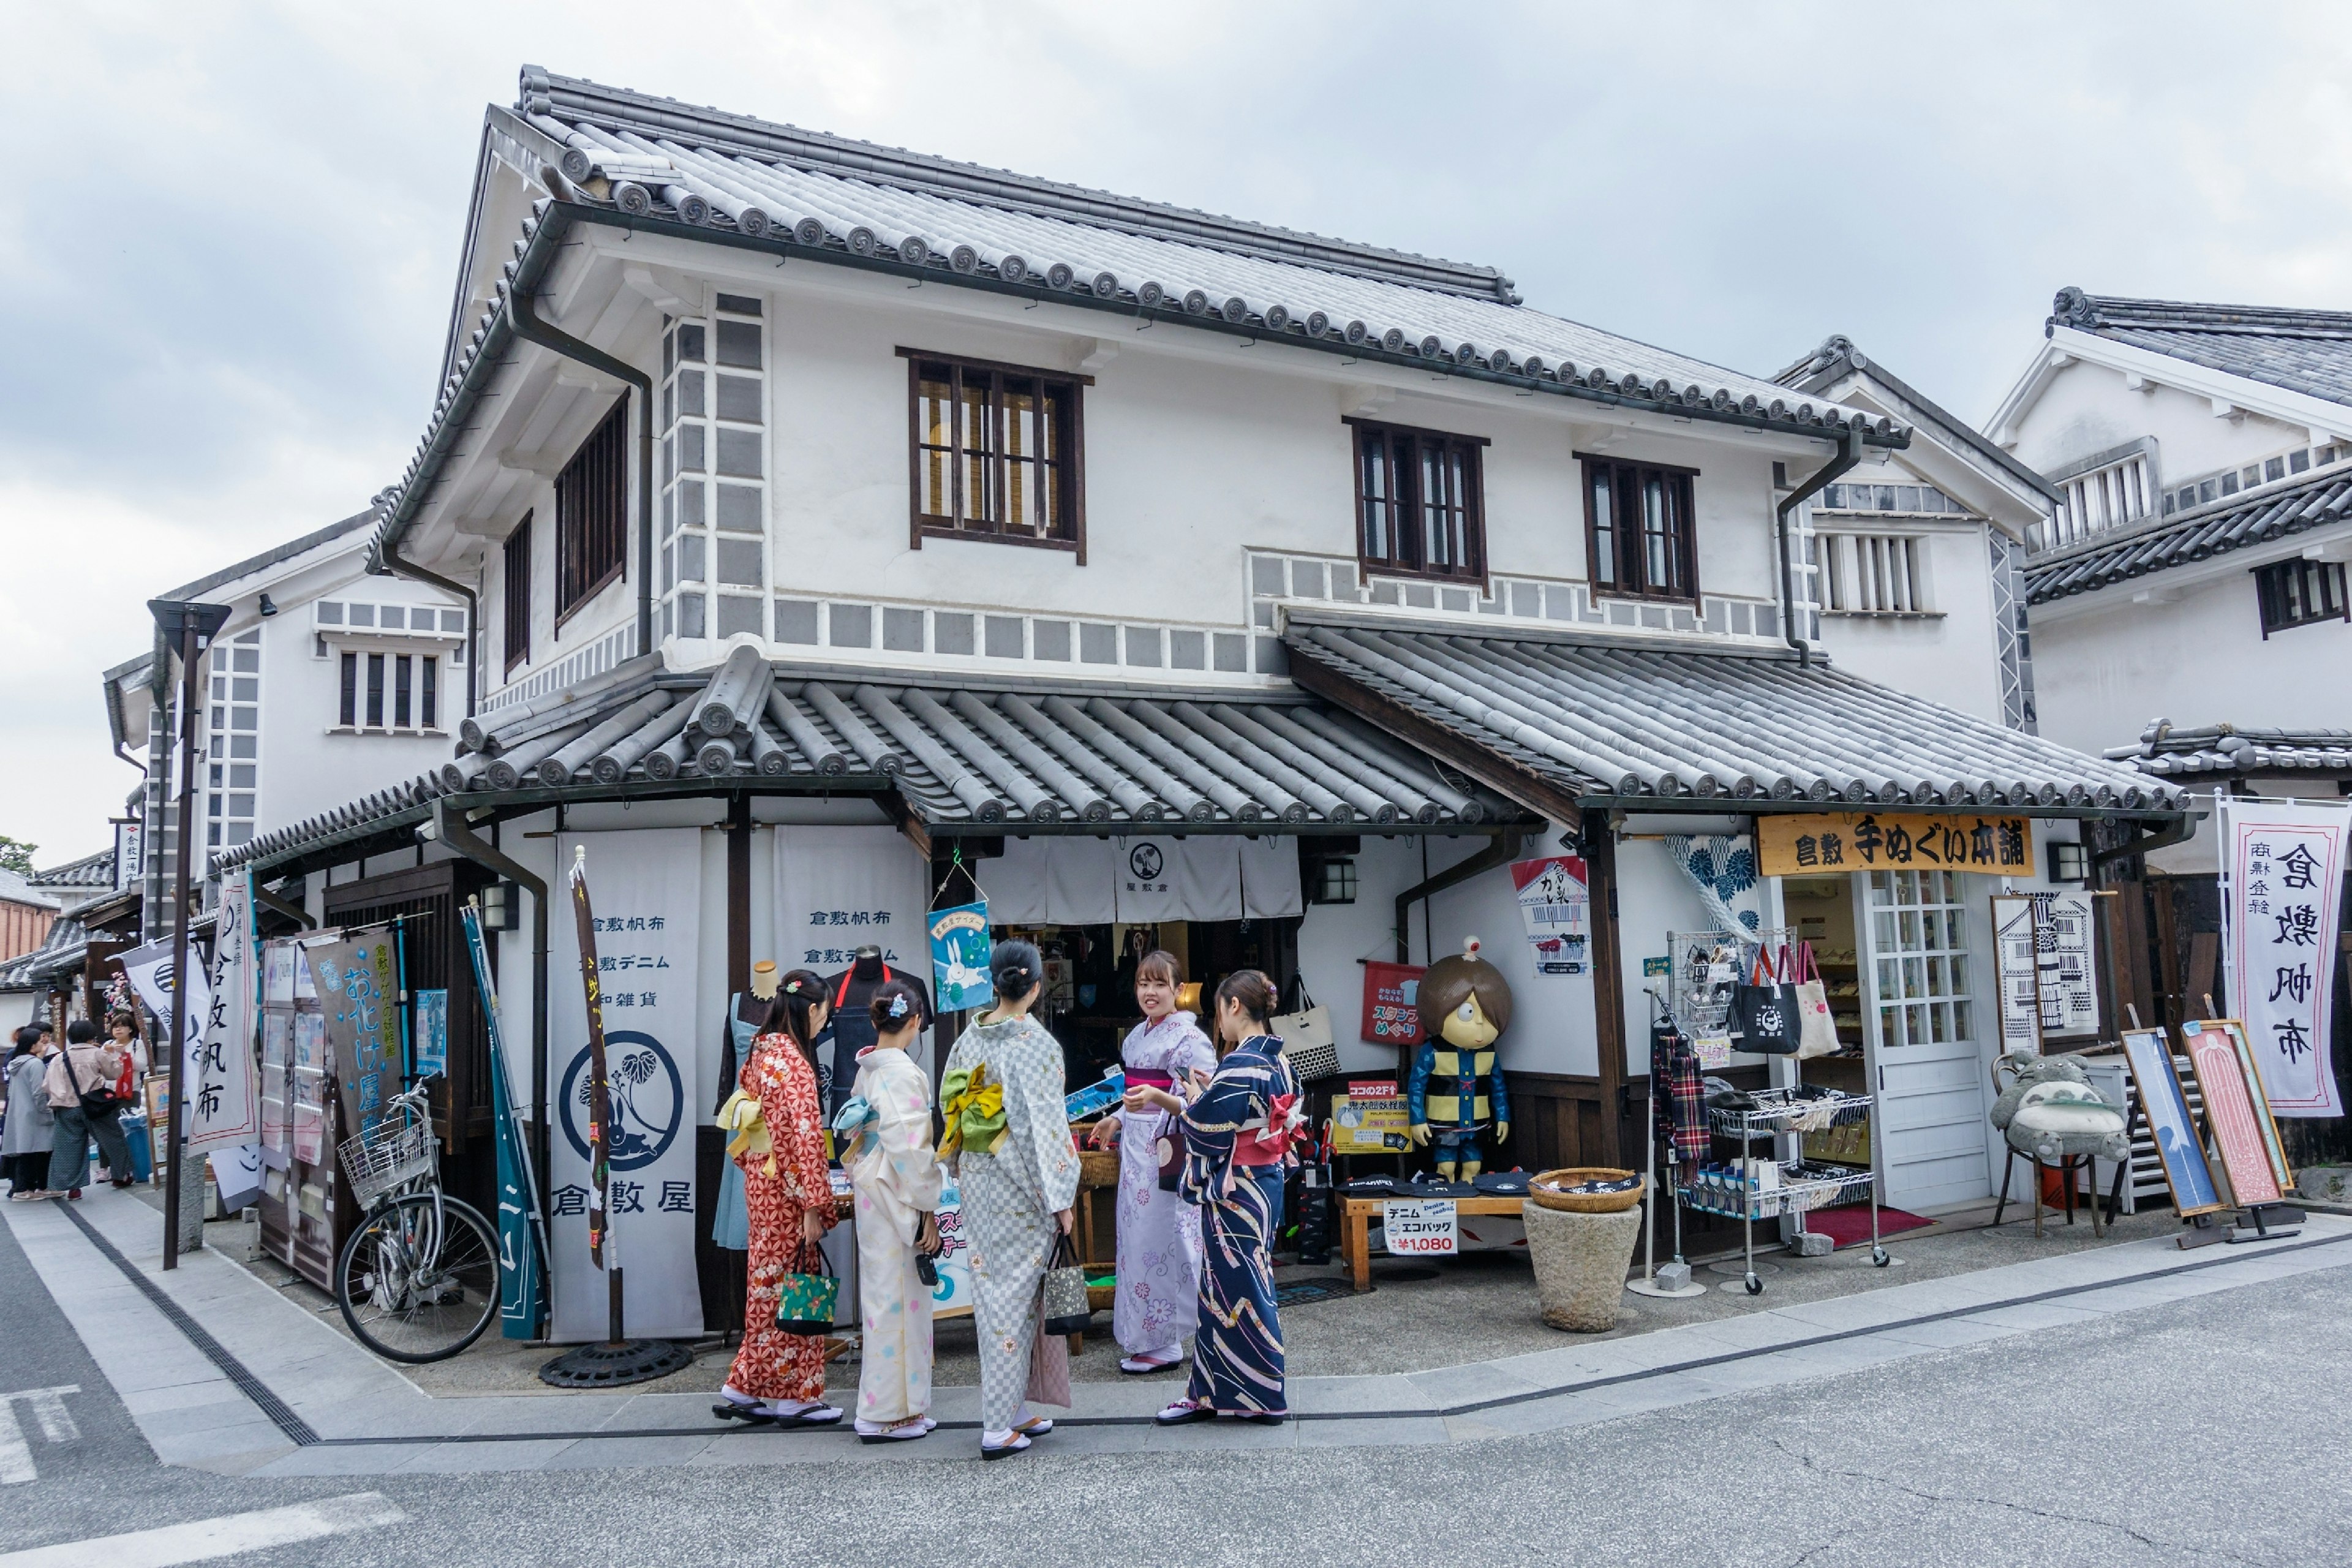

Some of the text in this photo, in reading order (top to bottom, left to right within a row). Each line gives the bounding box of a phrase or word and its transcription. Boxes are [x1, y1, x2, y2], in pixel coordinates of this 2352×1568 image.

[1795, 815, 2025, 866] 倉敷 手ぬぐい本舗
[810, 910, 891, 925] 倉敷帆布
[579, 954, 669, 971] 敷デニム
[319, 959, 343, 993] 妖怪
[1695, 967, 1708, 976] UV
[375, 944, 396, 1059] 倉敷ゲゲゲの妖怪館
[1375, 1020, 1416, 1038] めぐり
[551, 1180, 695, 1216] 倉敷屋
[1389, 1208, 1420, 1219] デニム
[1424, 1202, 1445, 1211] Denim
[1402, 1221, 1452, 1232] エコバッグ
[1398, 1237, 1452, 1252] ¥1,080
